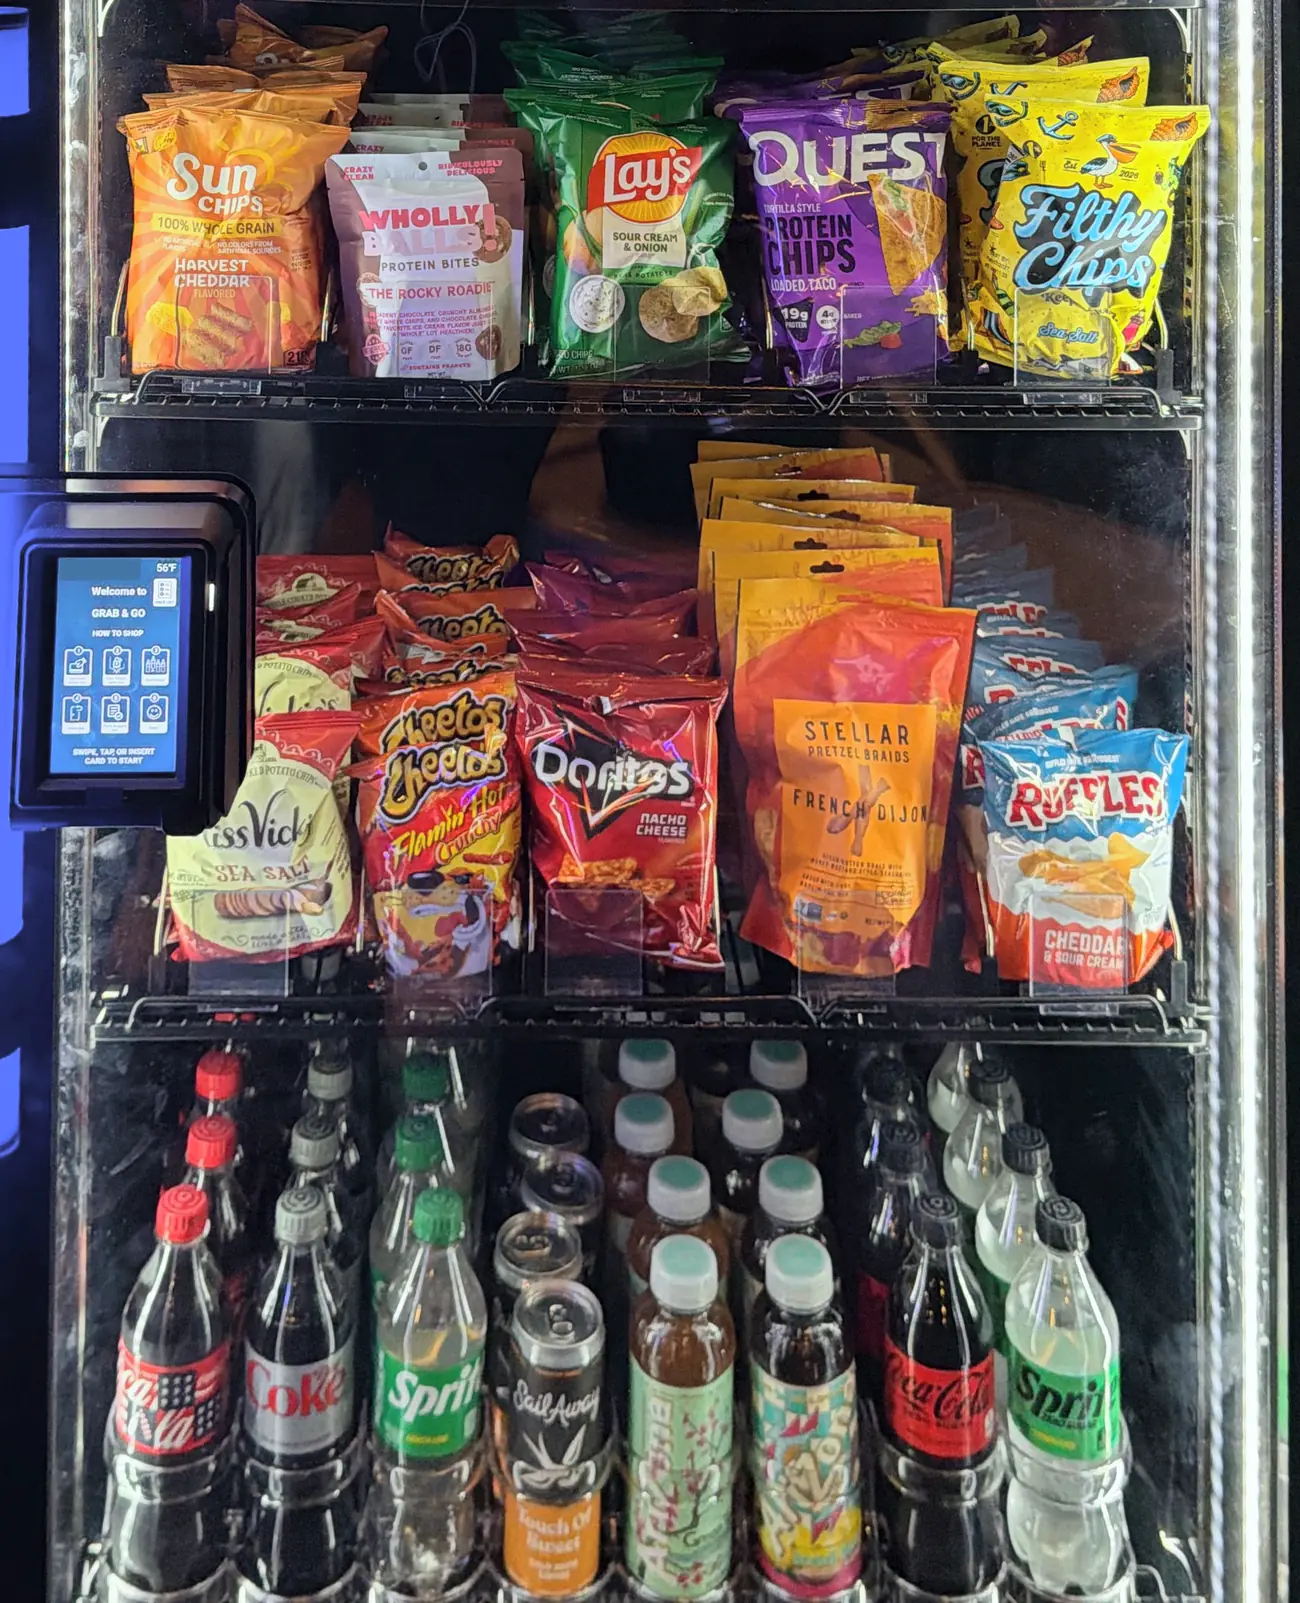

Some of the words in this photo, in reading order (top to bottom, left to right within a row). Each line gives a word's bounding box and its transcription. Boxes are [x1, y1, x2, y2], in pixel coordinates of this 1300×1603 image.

[748, 130, 948, 188] QUEST
[166, 152, 258, 201] Sun
[343, 166, 374, 174] CRAZY
[446, 167, 496, 177] DELICIOUS
[604, 147, 692, 204] Lay's
[198, 195, 263, 216] CHIPS
[764, 203, 795, 214] TORTILLA
[797, 202, 822, 213] STYLE
[158, 217, 190, 232] 100%
[192, 221, 233, 236] WHOLE
[236, 222, 275, 235] GRAIN
[1014, 182, 1167, 253] Filthy
[765, 214, 852, 240] PROTEIN
[613, 232, 641, 242] SOUR
[644, 233, 678, 243] CREAM
[634, 244, 668, 253] ONION
[767, 239, 856, 276] CHIPS
[174, 258, 249, 273] HARVEST
[381, 260, 436, 272] PROTEIN
[442, 257, 480, 269] BITES
[1013, 242, 1151, 297] Chips
[174, 274, 250, 288] CHEDDAR
[771, 279, 805, 292] LOADED
[808, 277, 836, 291] TACO
[194, 288, 236, 299] FLAVORED
[397, 286, 442, 300] ROCKY
[780, 307, 809, 321] 19g
[1037, 321, 1065, 339] Sea
[1067, 326, 1100, 344] Salt
[428, 345, 441, 353] DF
[456, 343, 472, 352] 18G
[91, 586, 136, 596] Welcome
[137, 587, 147, 596] to
[91, 608, 120, 618] GRAB
[121, 608, 129, 618] &
[130, 608, 146, 618] GO
[92, 629, 111, 637] HOW
[111, 629, 122, 637] TO
[122, 629, 145, 637] SHOP
[804, 720, 910, 746] STELLAR
[84, 757, 106, 765] CARD
[107, 757, 118, 765] TO
[118, 757, 144, 765] START
[808, 745, 860, 759] PRETZEL
[863, 747, 910, 764] BRAIDS
[531, 741, 691, 796] Doritos
[793, 788, 867, 819] FRENCH
[877, 803, 930, 823] DIJON
[1006, 772, 1165, 830] RUFFLES
[640, 813, 687, 826] NACHO
[203, 825, 250, 849] iss
[636, 825, 687, 837] CHEESE
[215, 865, 257, 882] SEA
[263, 854, 311, 881] SALT
[1044, 929, 1128, 951] CHEDDAR
[1044, 953, 1052, 963] &
[1055, 952, 1084, 966] SOUR
[1086, 952, 1124, 970] CREAM
[247, 1359, 346, 1417] Coke
[513, 1378, 553, 1418] Sail
[544, 1386, 601, 1428] Away
